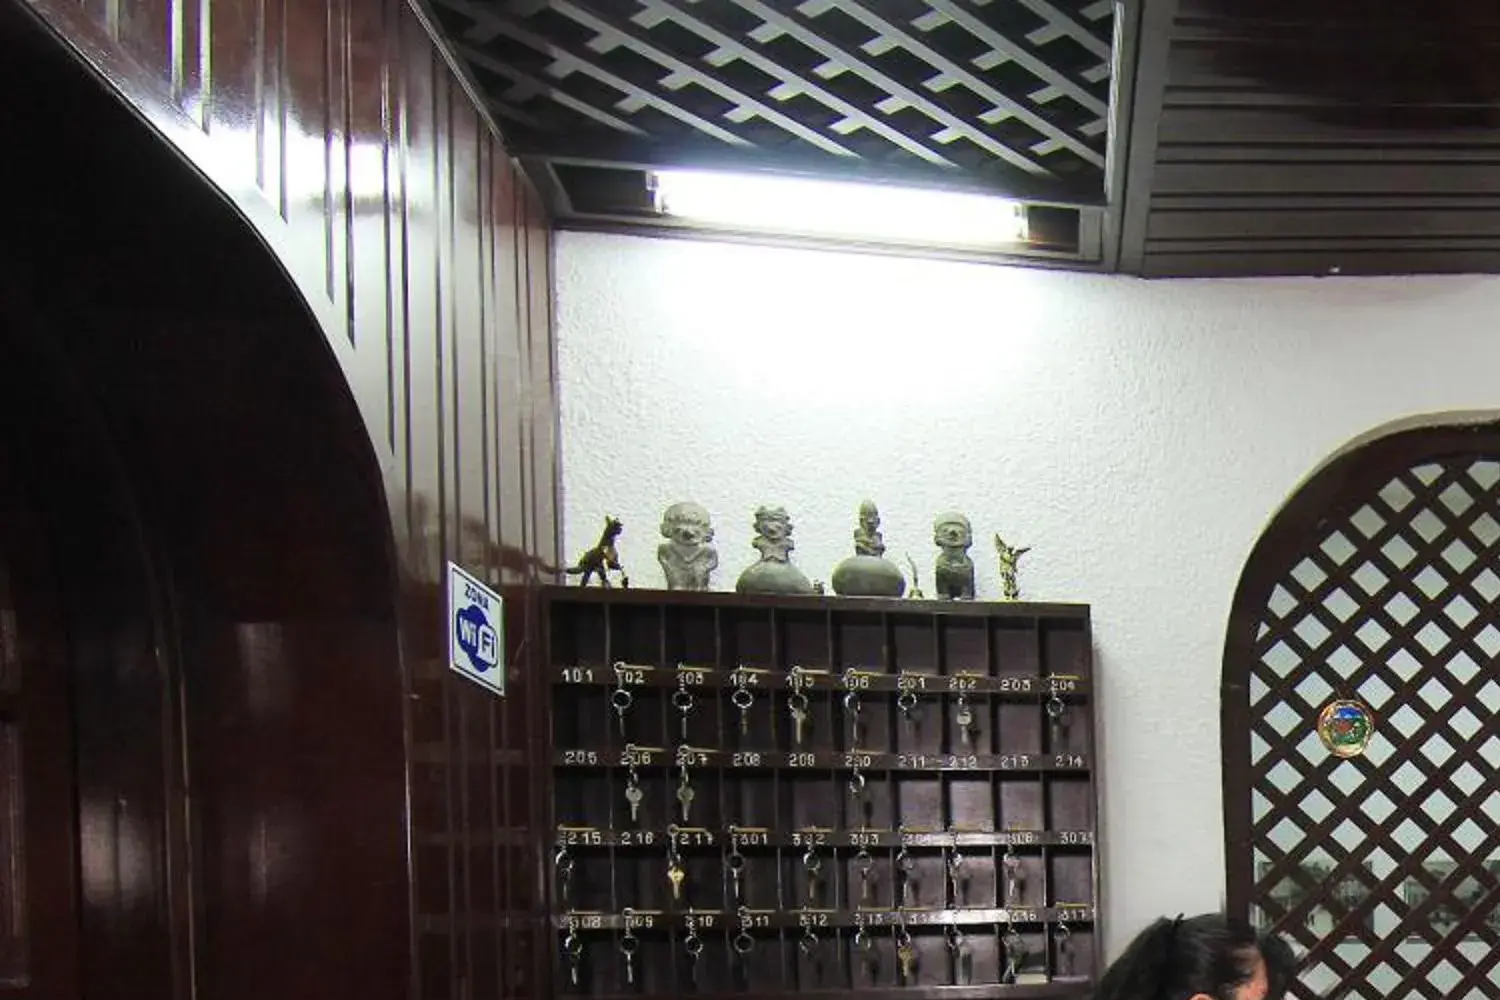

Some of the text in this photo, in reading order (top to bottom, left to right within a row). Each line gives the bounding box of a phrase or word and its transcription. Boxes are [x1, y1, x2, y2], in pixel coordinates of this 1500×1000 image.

[562, 668, 593, 683] 101
[1000, 679, 1032, 691] 203
[565, 751, 597, 765] 205
[733, 752, 761, 767] 208
[788, 752, 816, 767] 209
[897, 755, 926, 769] 211
[567, 831, 601, 845] 215
[620, 831, 654, 845] 216
